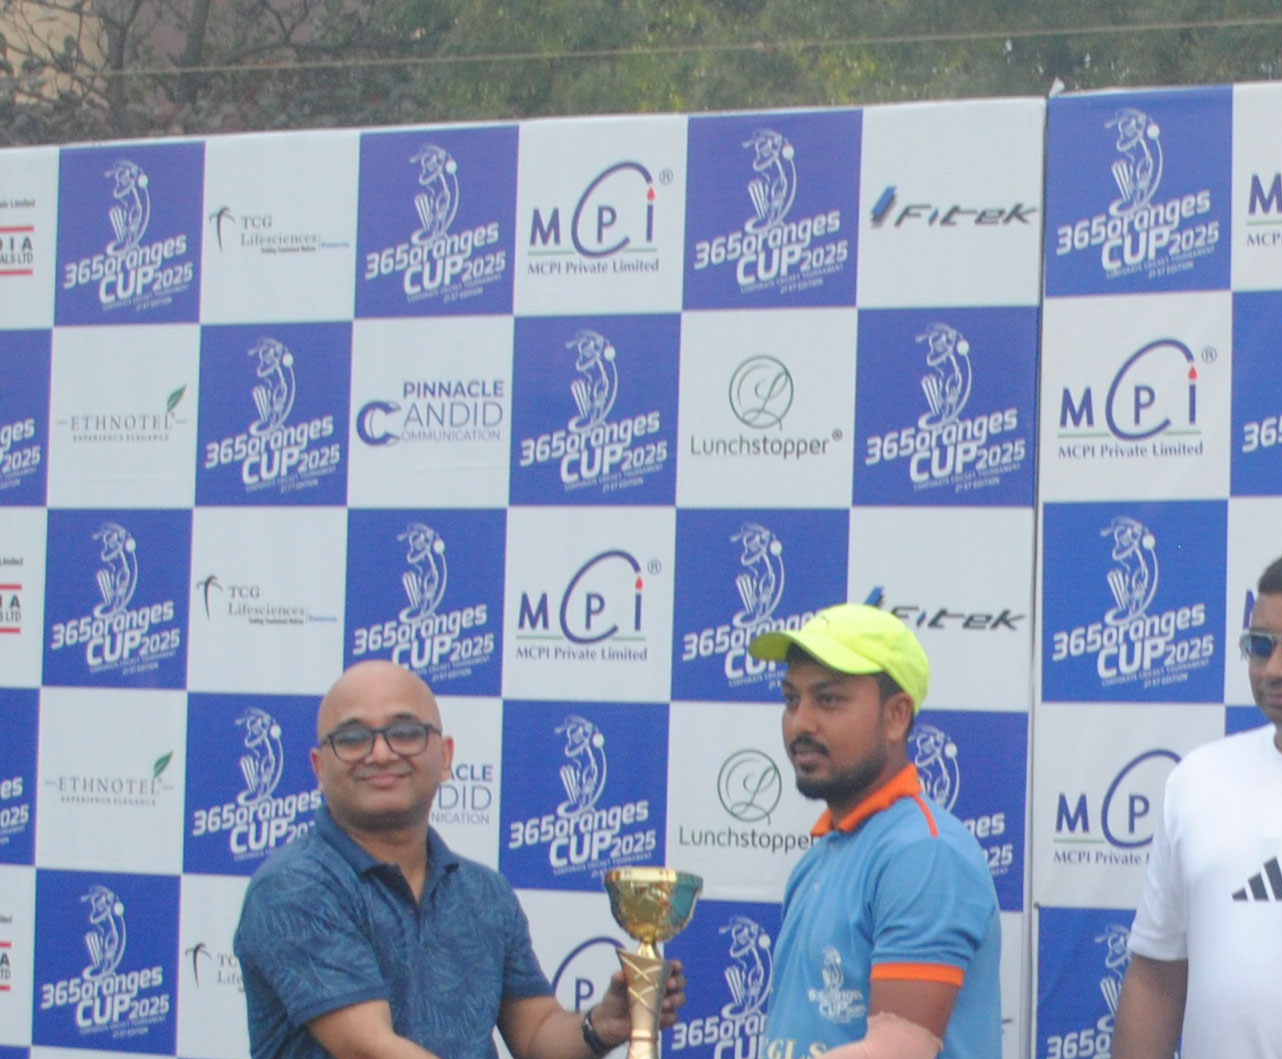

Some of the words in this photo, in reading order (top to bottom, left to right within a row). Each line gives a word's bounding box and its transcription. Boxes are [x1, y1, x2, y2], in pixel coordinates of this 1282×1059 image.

[241, 216, 273, 229] TCG
[693, 209, 840, 270] 365oranges
[1055, 189, 1210, 255] 365oranges
[63, 234, 186, 289] 365oranges
[364, 221, 498, 280] 365oranges
[527, 262, 560, 276] MCPI
[565, 260, 607, 274] Private
[612, 258, 658, 273] Limited
[402, 380, 504, 399] PINNACLE
[71, 414, 173, 431] ETHNOTEL
[204, 415, 333, 468] 365oranges
[519, 410, 659, 466] 365oranges
[864, 407, 1017, 465] 365oranges
[1058, 445, 1094, 459] MCPI
[1100, 443, 1146, 458] Private
[1152, 441, 1202, 457] Limited
[229, 586, 260, 599] TCG
[50, 600, 173, 649] 365oranges
[352, 604, 486, 654] 365oranges
[1051, 603, 1205, 661] 365oranges
[516, 647, 549, 660] MCPI
[554, 646, 596, 660] Private
[600, 647, 646, 661] Limited
[58, 776, 159, 796] ETHNOTEL
[192, 788, 321, 836] 365oranges
[508, 800, 648, 849] 365oranges
[1053, 849, 1089, 863] MCPI
[1094, 850, 1140, 865] Private
[40, 966, 162, 1009] 365oranges
